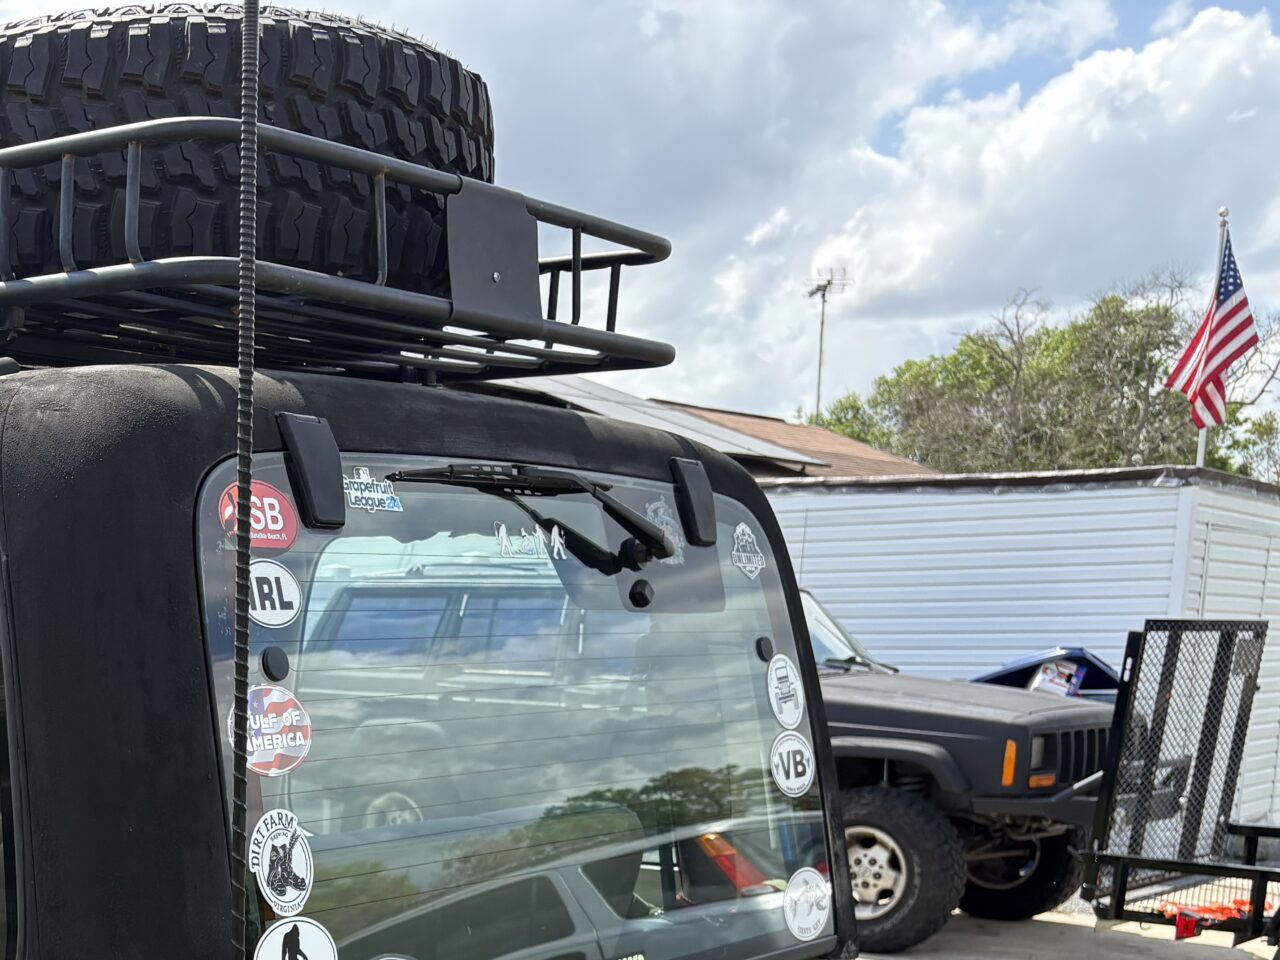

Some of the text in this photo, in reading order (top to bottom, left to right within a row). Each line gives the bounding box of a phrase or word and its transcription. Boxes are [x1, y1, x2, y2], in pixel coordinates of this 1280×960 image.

[349, 493, 386, 510] League
[248, 711, 301, 730] ULF OF
[778, 749, 807, 780] VB
[251, 811, 295, 870] DIRT FARM
[273, 900, 302, 913] VIRGINIA
